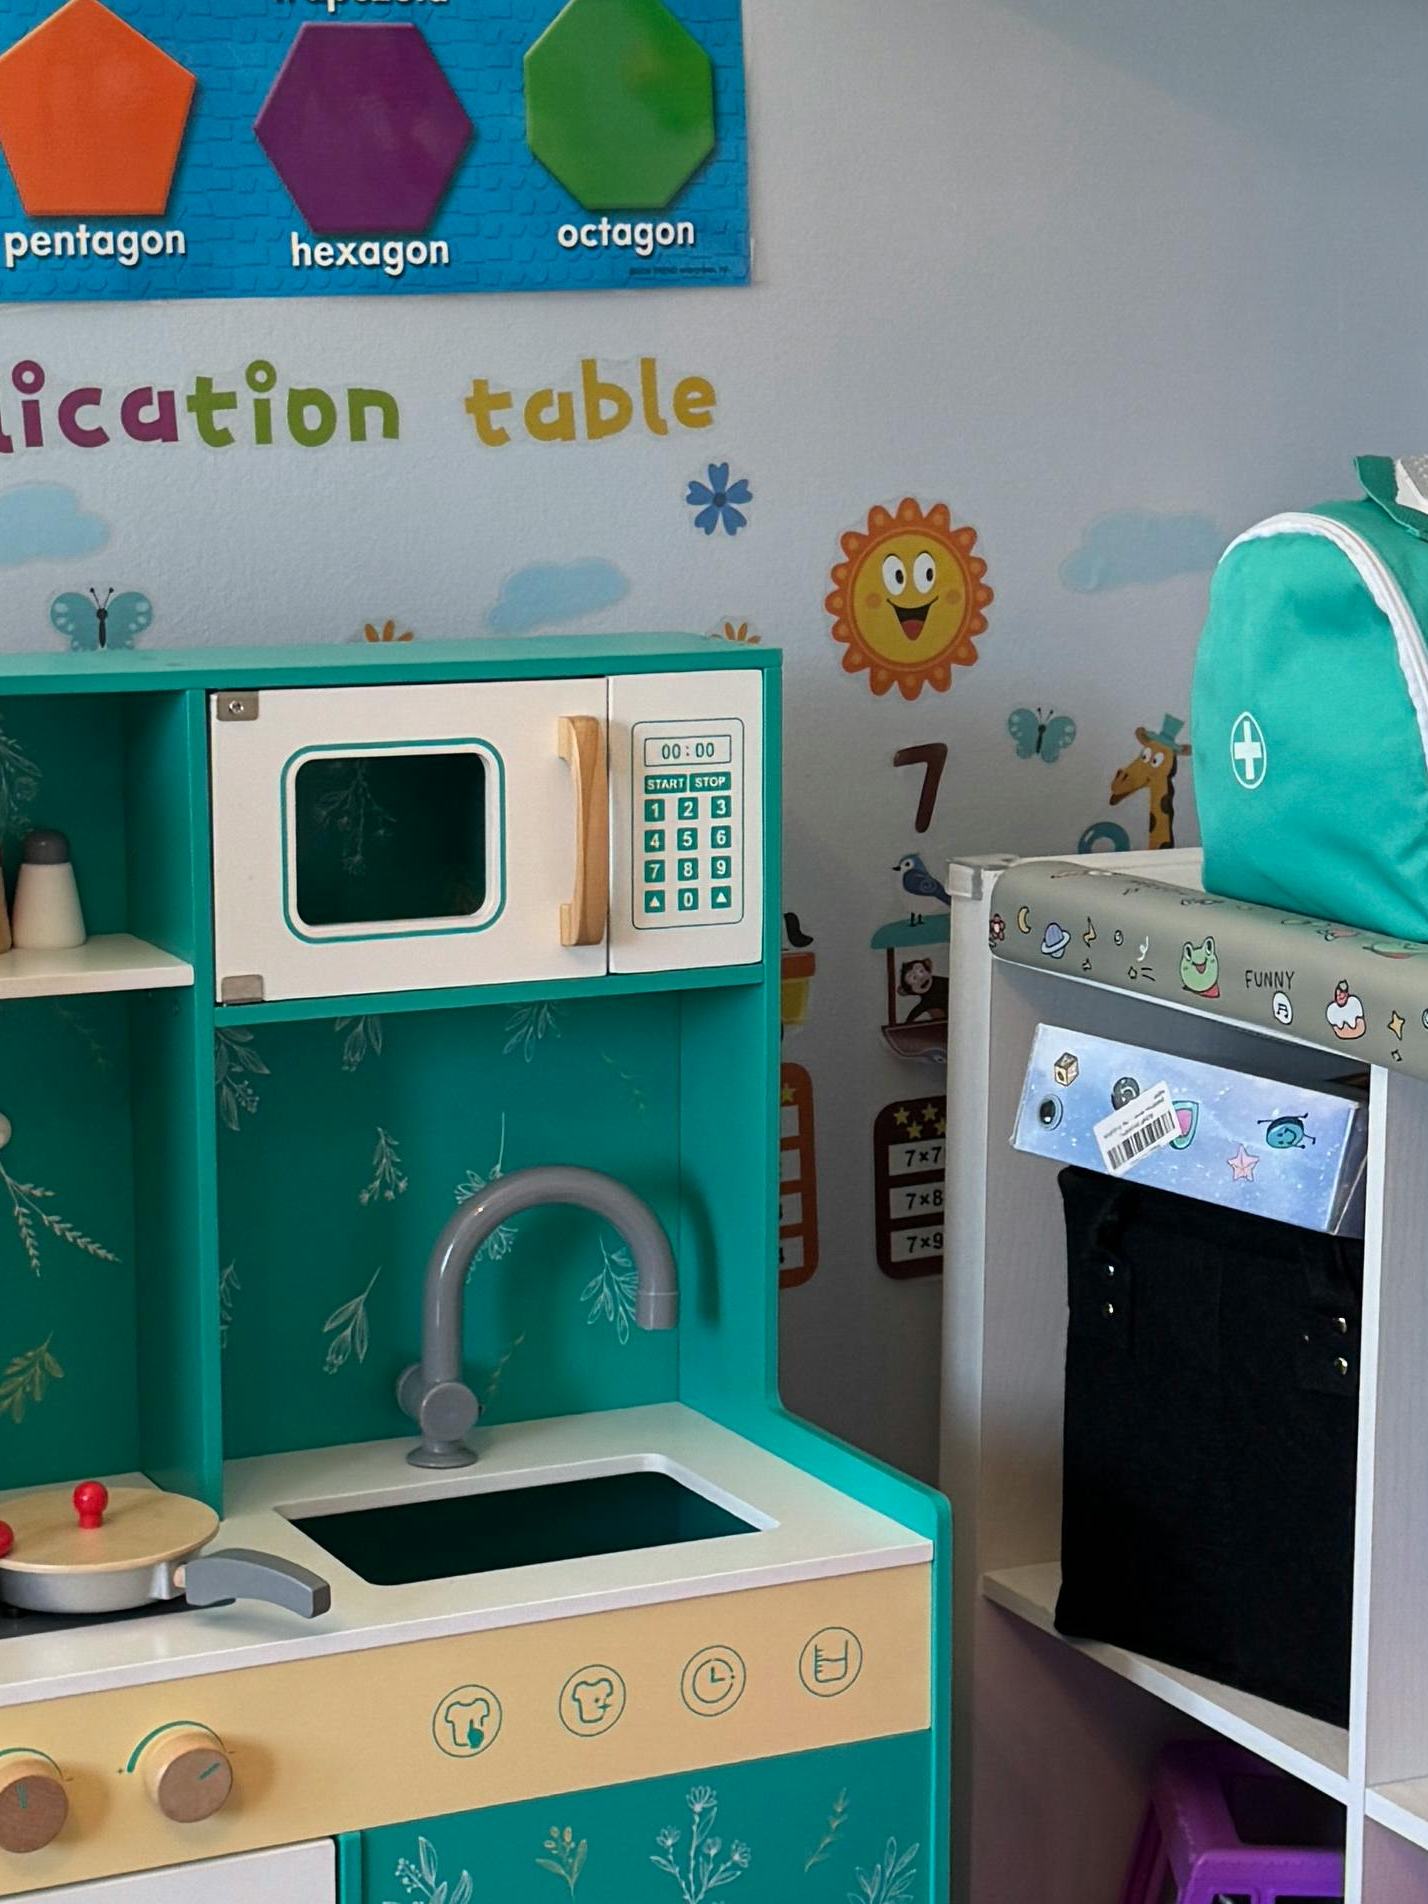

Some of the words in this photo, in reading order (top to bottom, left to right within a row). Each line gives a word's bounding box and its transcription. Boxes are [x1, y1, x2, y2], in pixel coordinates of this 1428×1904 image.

[4, 224, 187, 267] pentagon
[557, 217, 696, 258] octagon
[291, 232, 451, 276] hexagon
[463, 357, 719, 449] table
[647, 777, 686, 793] START
[694, 774, 727, 790] STOP
[893, 742, 948, 834] 7
[650, 802, 660, 819] 1
[682, 800, 695, 817] 2
[715, 798, 728, 816] 3
[649, 832, 661, 849] 4
[682, 830, 694, 848] 5
[715, 829, 727, 847] 6
[649, 862, 661, 880] 7
[682, 860, 694, 878] 8
[715, 859, 727, 877] 9
[682, 891, 694, 909] 0
[1245, 969, 1296, 990] FUNNY
